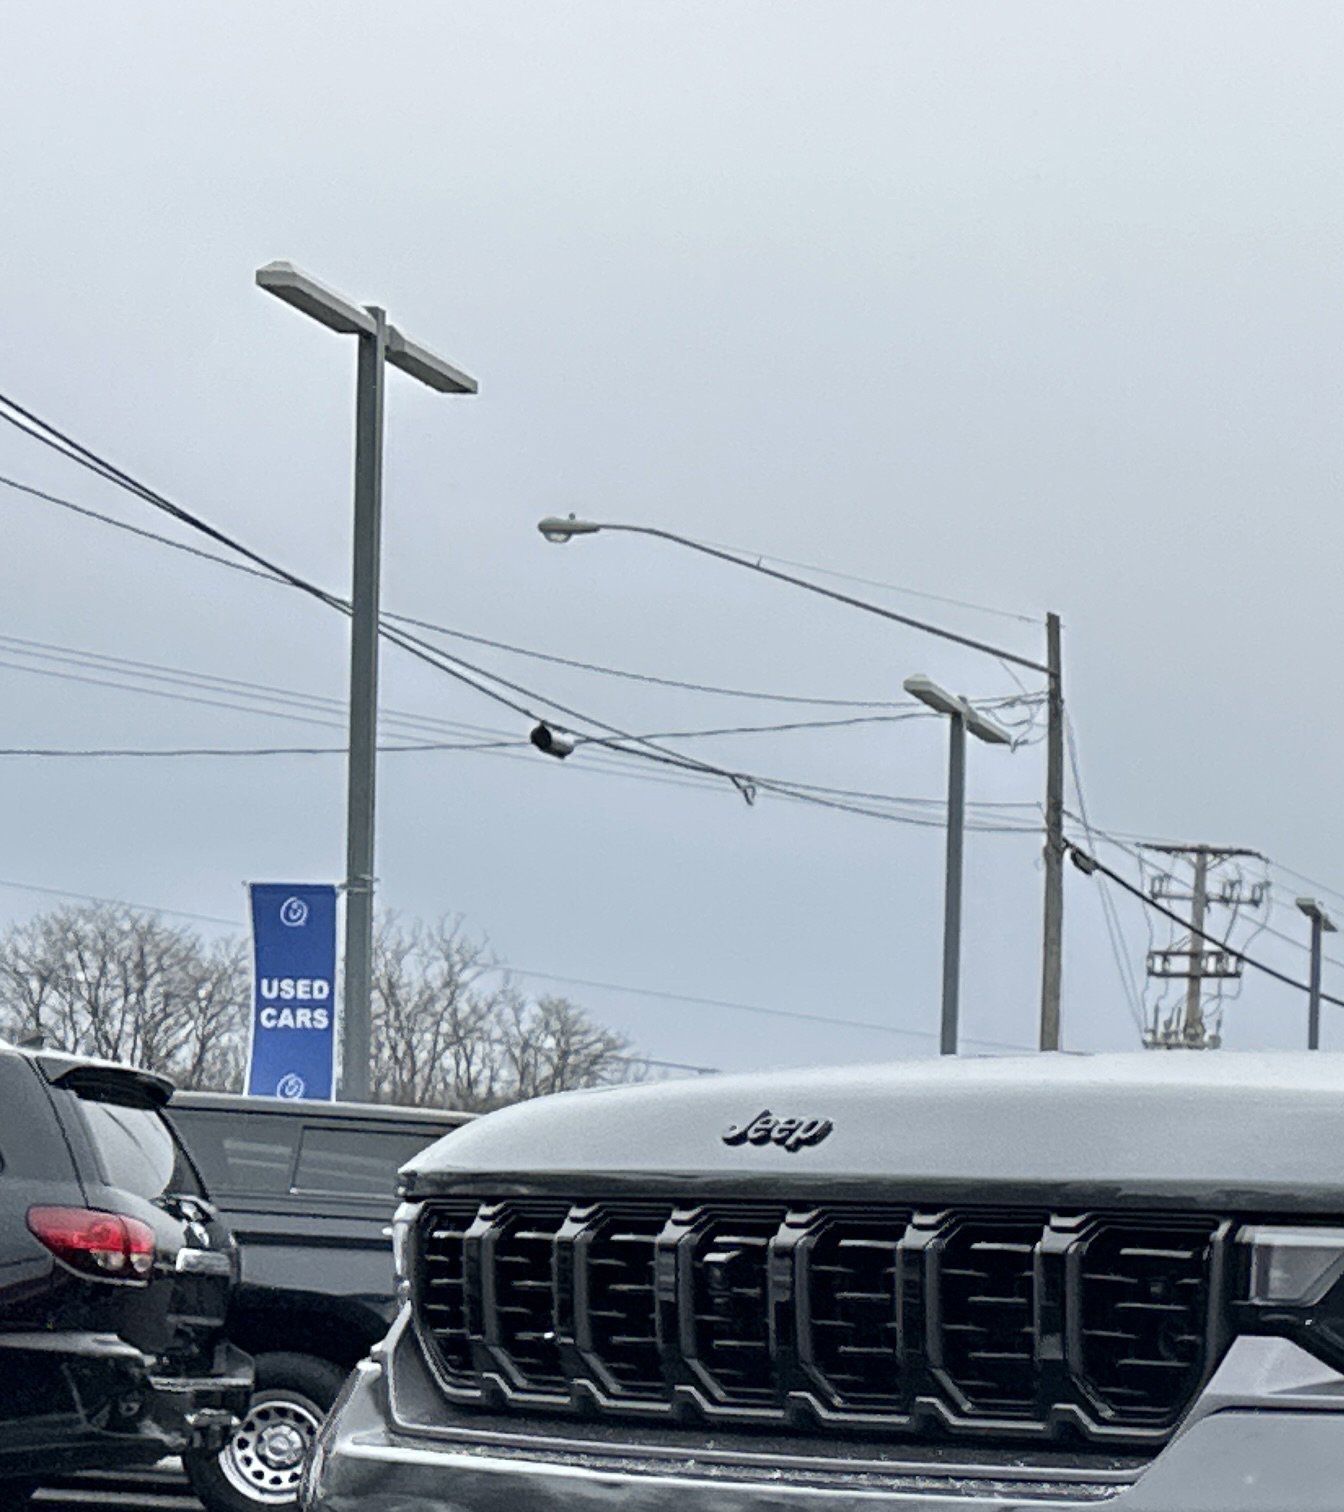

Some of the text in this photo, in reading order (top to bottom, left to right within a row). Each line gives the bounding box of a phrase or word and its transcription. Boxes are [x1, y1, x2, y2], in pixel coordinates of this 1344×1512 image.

[260, 977, 330, 1000] USED
[260, 1007, 330, 1030] CARS
[721, 1109, 834, 1153] Jeep
